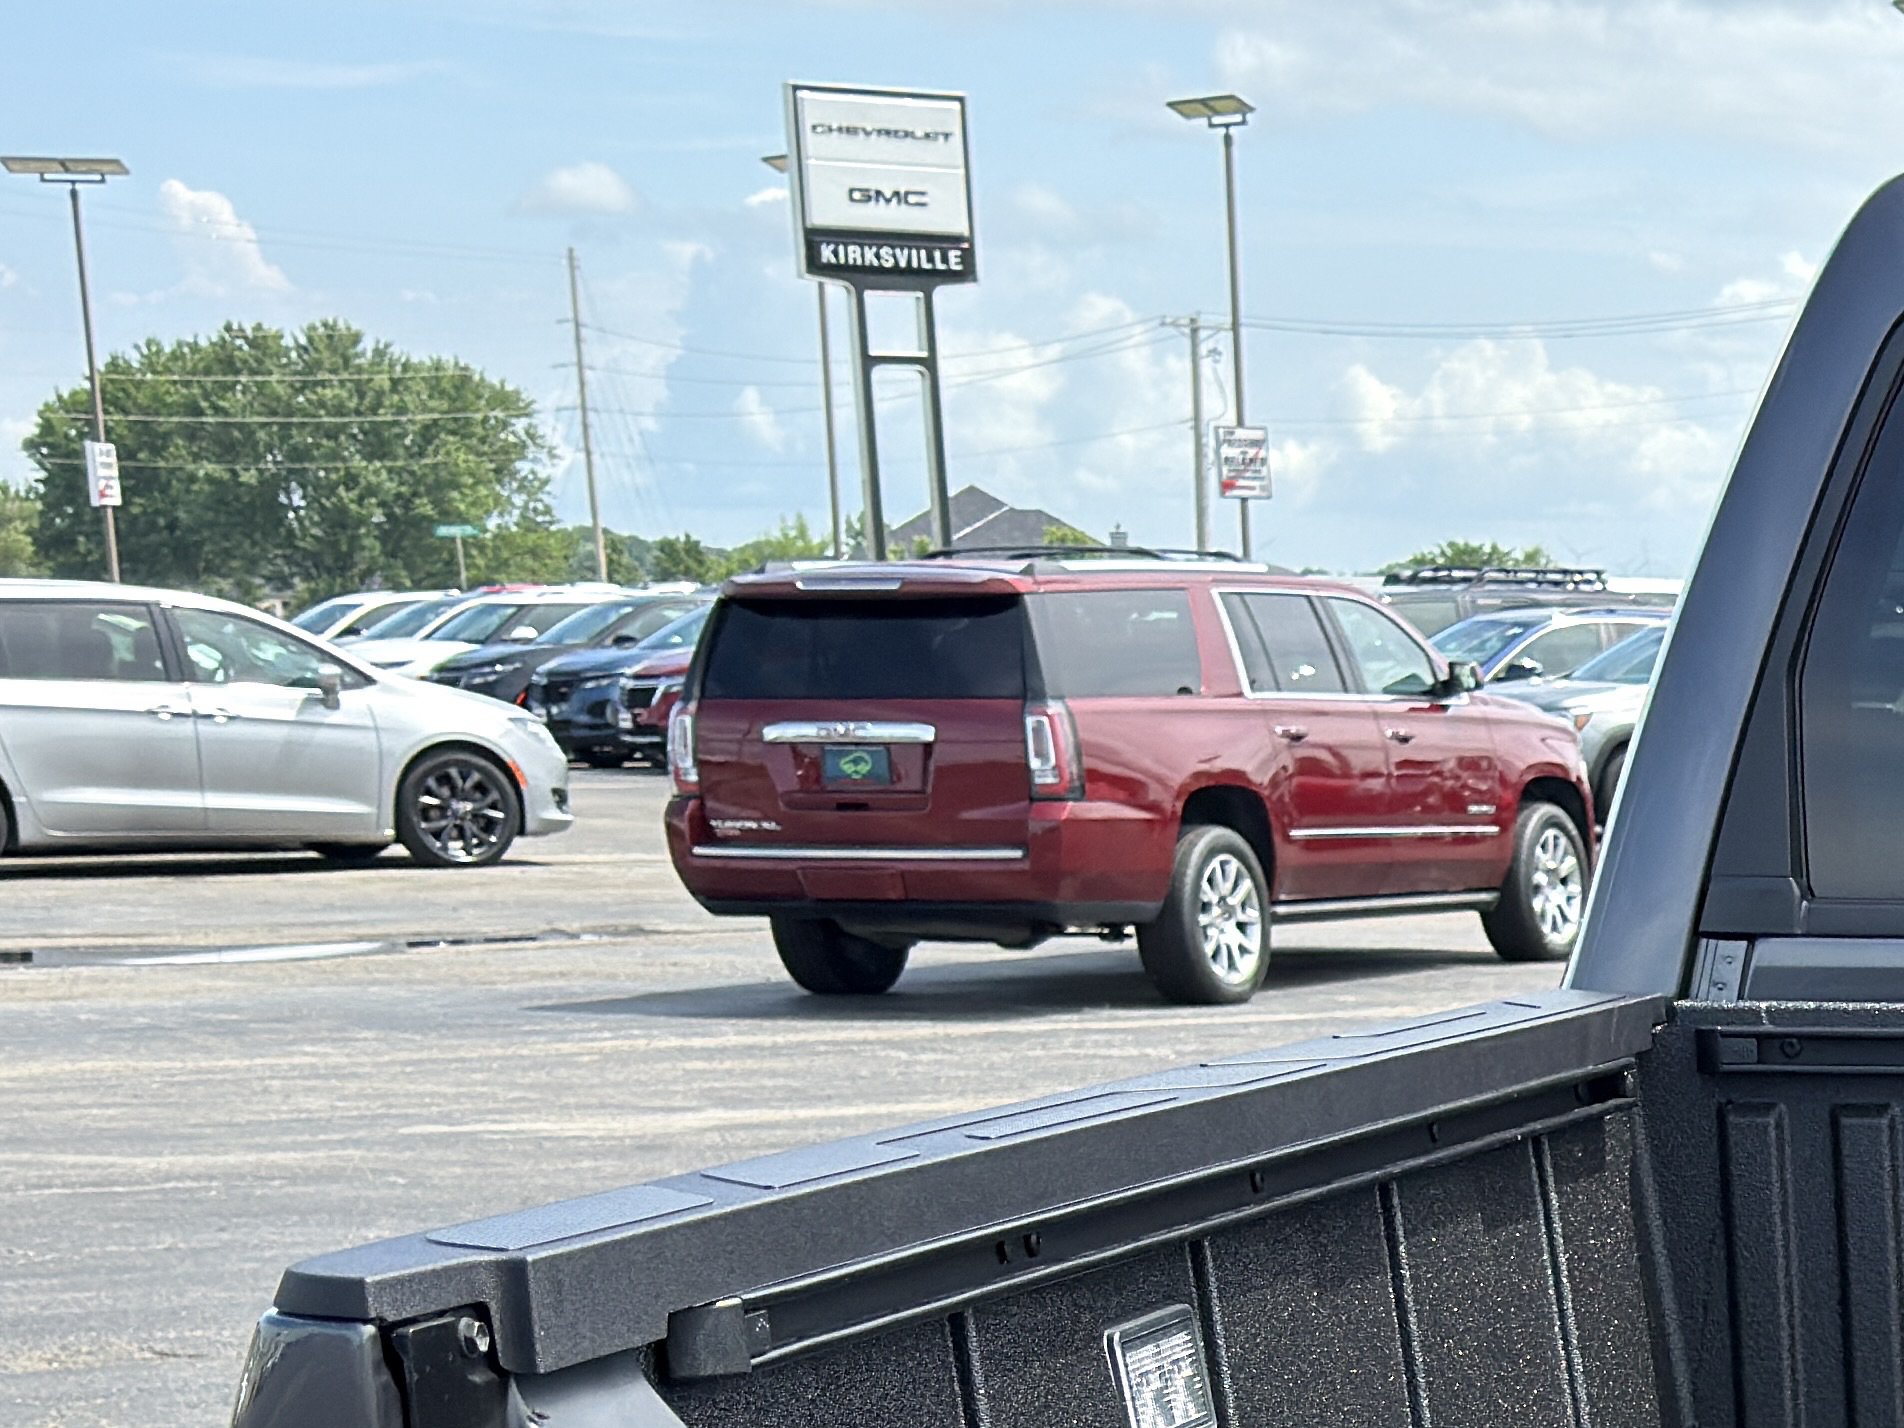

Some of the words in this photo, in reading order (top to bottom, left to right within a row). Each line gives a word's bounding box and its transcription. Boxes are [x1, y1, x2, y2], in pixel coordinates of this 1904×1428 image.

[811, 122, 953, 144] CHEVROLET
[848, 187, 928, 207] GMC
[819, 241, 964, 271] KIRKSVILLE
